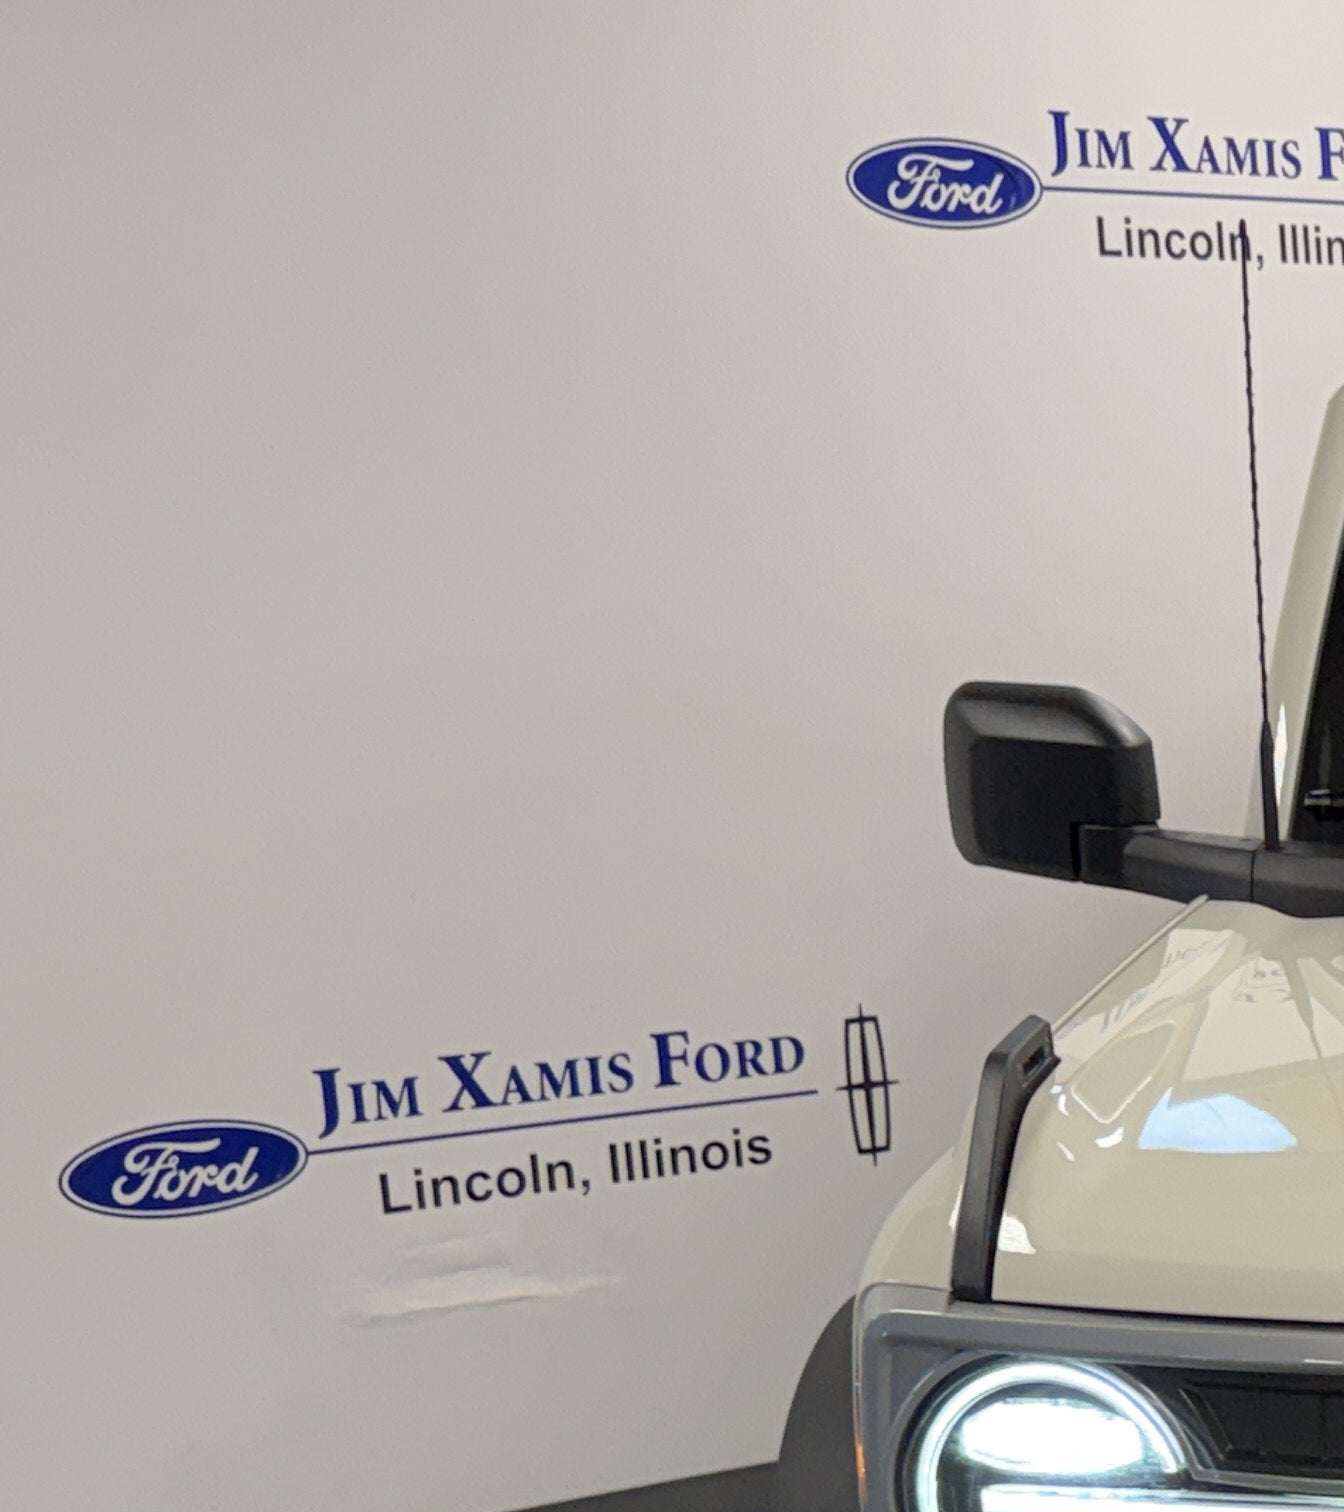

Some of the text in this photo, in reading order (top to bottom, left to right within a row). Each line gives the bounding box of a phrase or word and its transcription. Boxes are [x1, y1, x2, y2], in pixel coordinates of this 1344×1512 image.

[1049, 111, 1132, 176] JIM
[1148, 117, 1301, 178] XAMIS
[888, 154, 1003, 213] Ford
[1097, 217, 1262, 269] Lincoln,
[313, 1031, 803, 1138] JIM XAMIS FORD
[112, 1139, 258, 1205] Ford
[380, 1129, 771, 1214] Lincoln, Illinois
